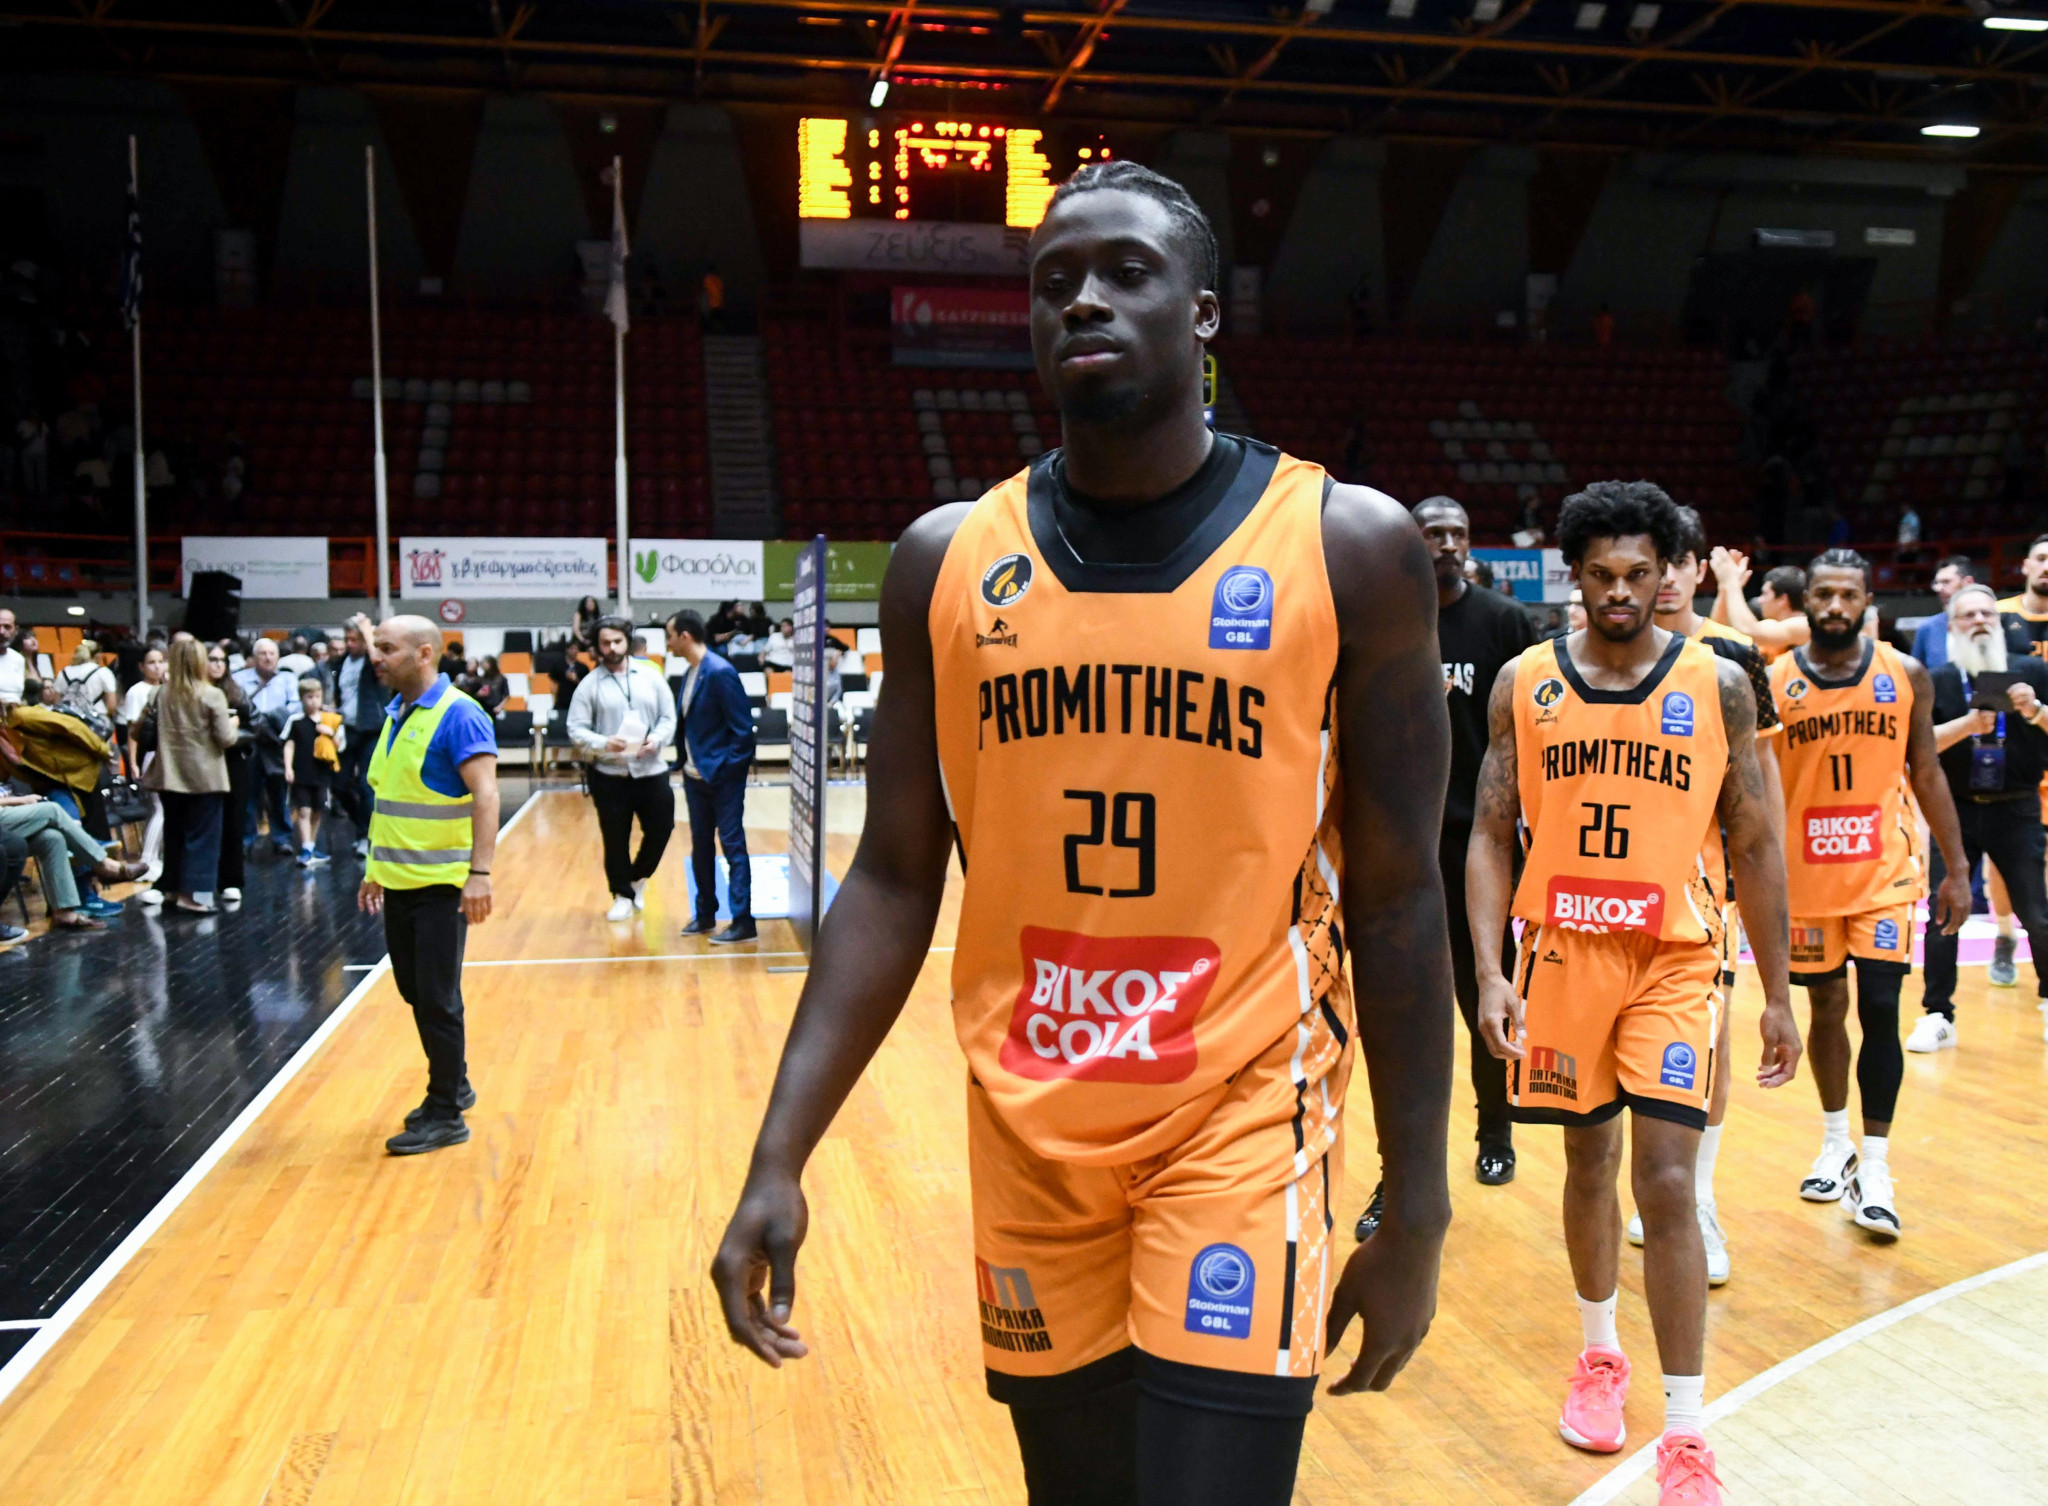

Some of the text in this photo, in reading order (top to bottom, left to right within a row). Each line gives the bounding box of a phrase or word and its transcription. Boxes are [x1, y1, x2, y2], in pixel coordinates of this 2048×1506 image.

[1212, 617, 1270, 628] Stoiximan
[1225, 632, 1254, 643] GBL
[979, 664, 1265, 759] PROMITHEAS
[1787, 710, 1897, 750] PROMITHEAS
[1828, 754, 1853, 791] 11
[1063, 789, 1156, 897] 29
[1579, 802, 1631, 859] 26
[1811, 836, 1872, 856] COLA
[1025, 1012, 1159, 1065] COLA
[1189, 1299, 1250, 1316] Stoiximan
[1202, 1315, 1232, 1330] GBL
